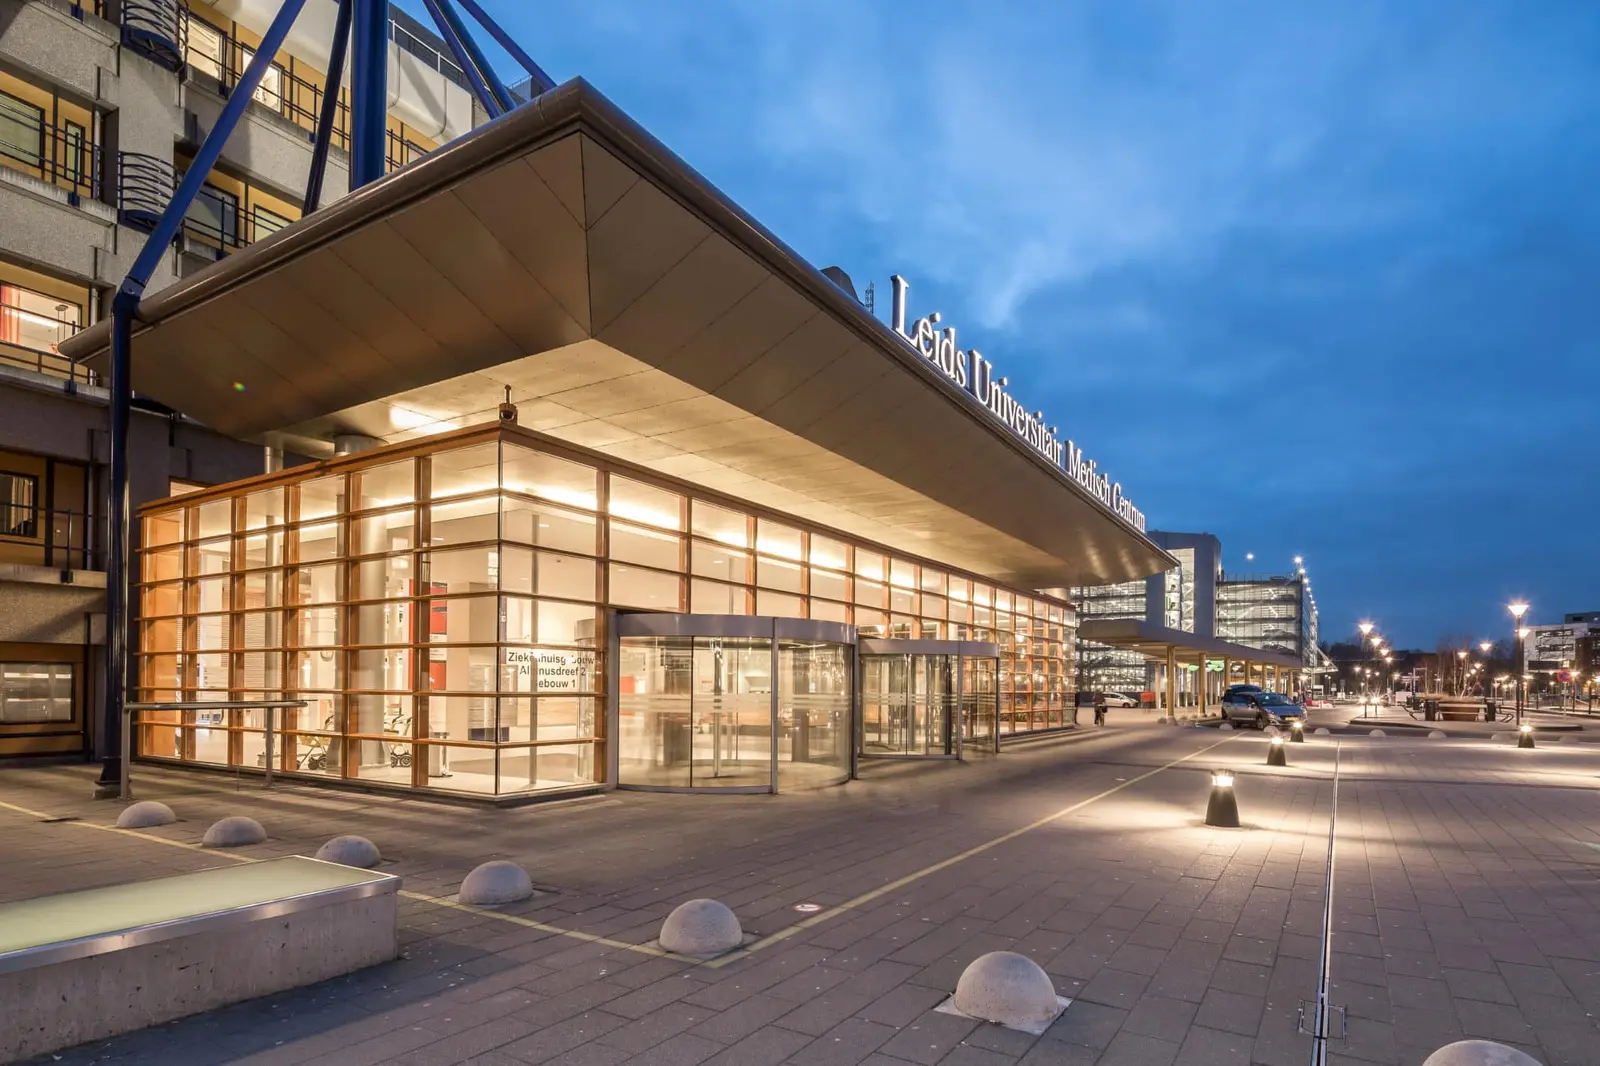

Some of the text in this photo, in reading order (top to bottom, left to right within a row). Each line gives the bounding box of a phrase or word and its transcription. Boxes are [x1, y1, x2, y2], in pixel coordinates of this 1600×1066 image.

[891, 275, 1145, 533] Leids Universitair Medisch Centrum
[519, 665, 586, 676] Alnusdreef 2
[537, 679, 576, 688] ebouw 1
